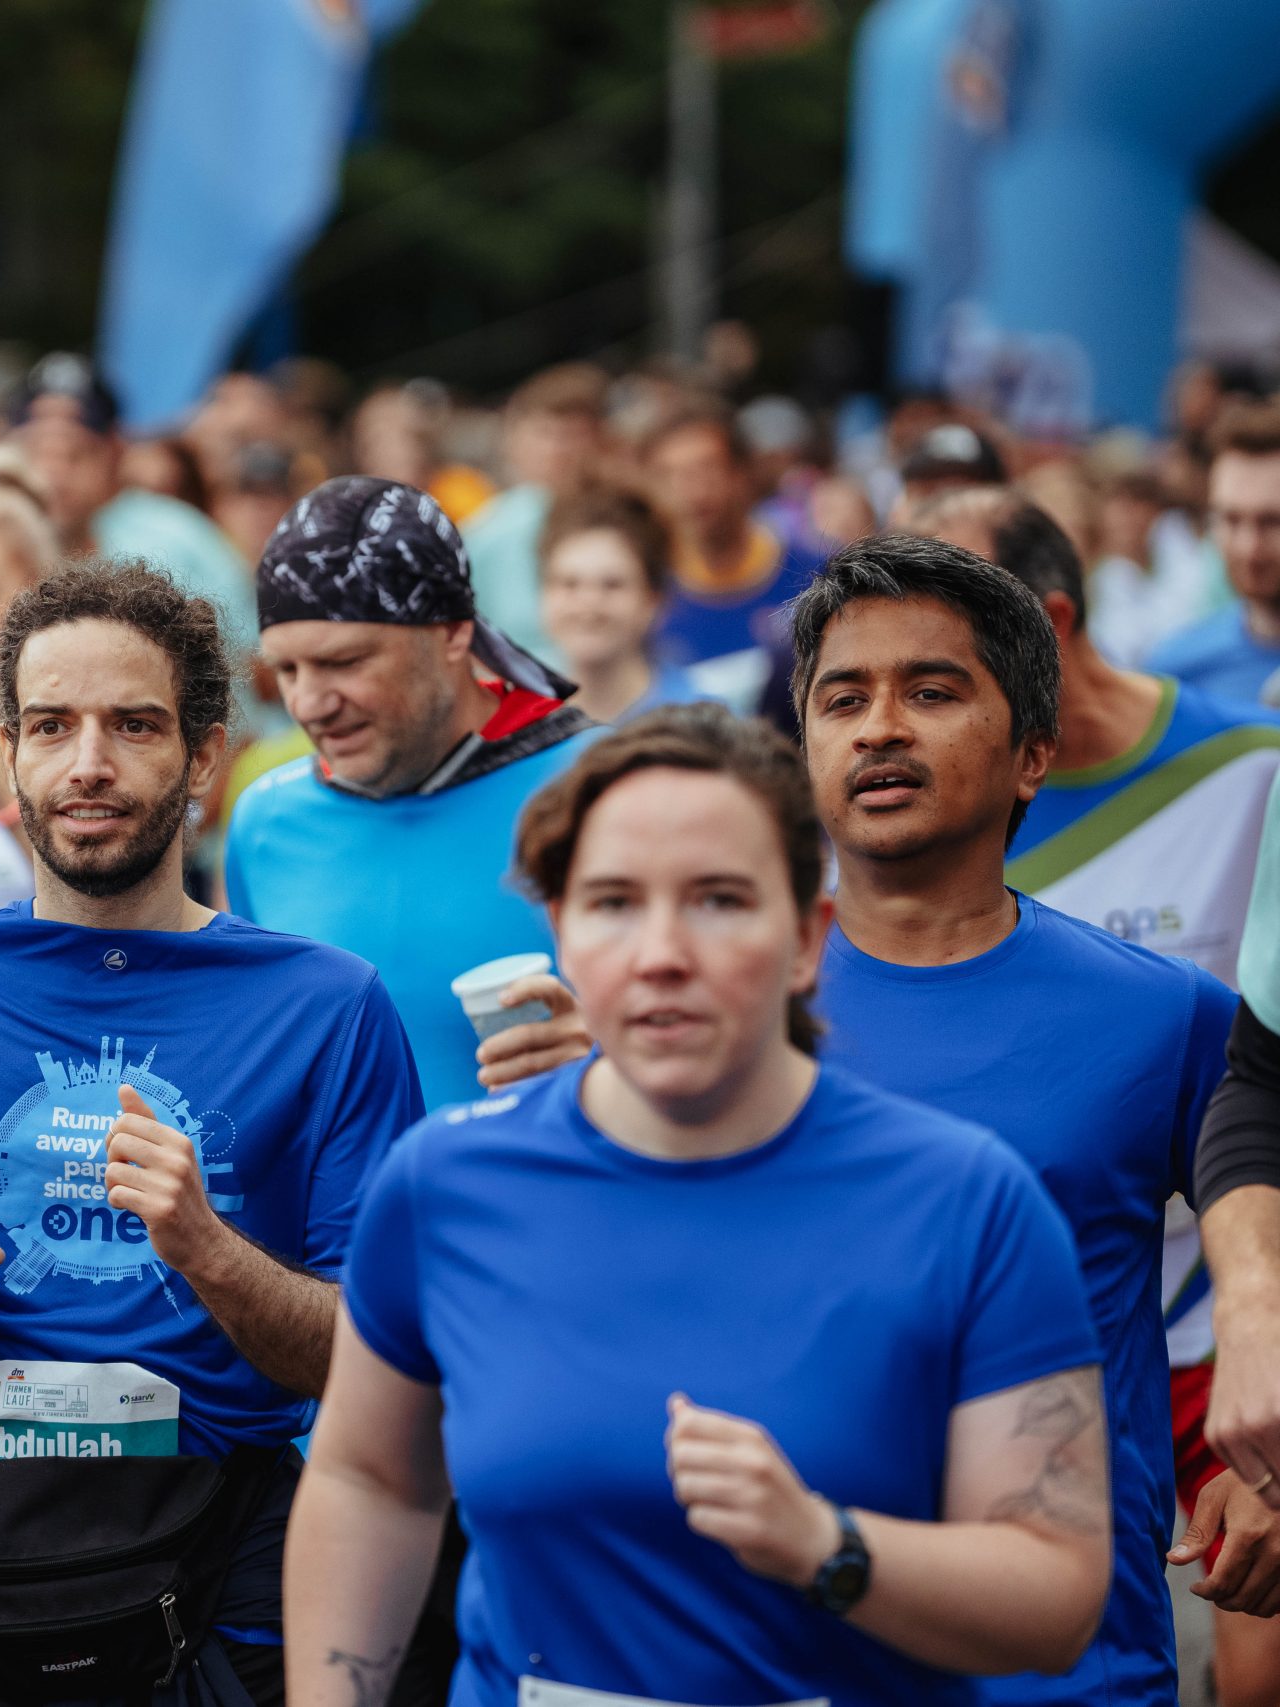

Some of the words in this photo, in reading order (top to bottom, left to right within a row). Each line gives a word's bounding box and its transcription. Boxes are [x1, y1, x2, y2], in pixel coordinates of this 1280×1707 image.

[36, 1134, 103, 1159] away
[64, 1160, 108, 1182] pap
[44, 1176, 106, 1200] since
[41, 1204, 149, 1244] one
[11, 1368, 24, 1376] dm
[6, 1394, 31, 1406] LAUF
[7, 1385, 32, 1394] FIRMEN
